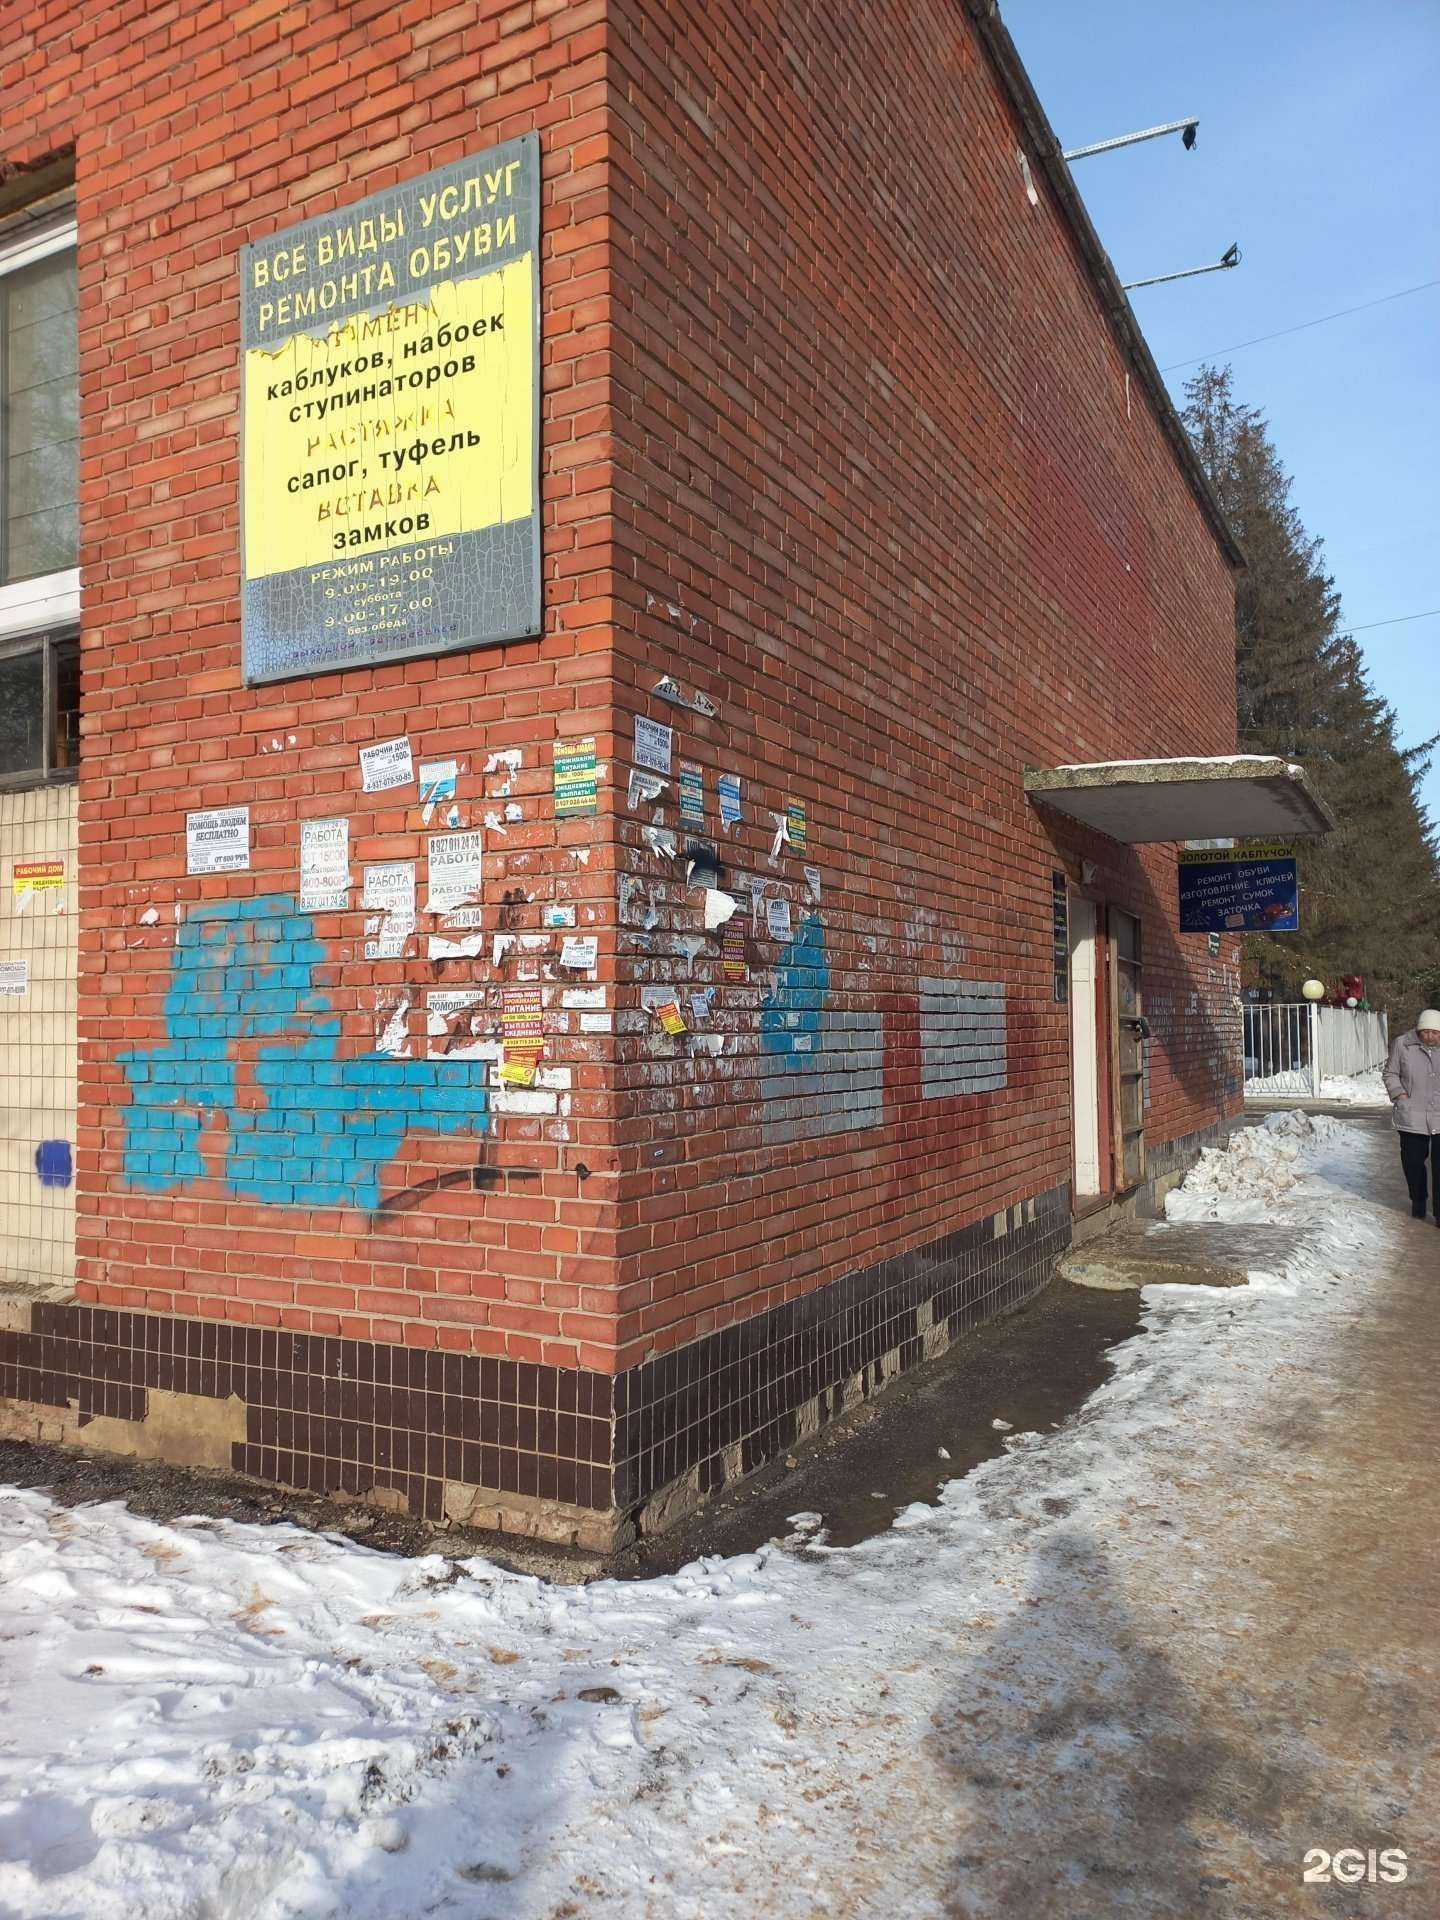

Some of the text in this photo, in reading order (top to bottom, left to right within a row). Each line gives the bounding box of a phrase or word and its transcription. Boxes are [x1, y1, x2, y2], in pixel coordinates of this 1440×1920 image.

[254, 160, 521, 288] ВСЕ ВИДЫ УСЛУГ
[259, 214, 516, 331] РЕМОНТА ОБУВИ
[267, 312, 504, 400] каблуков, набоек
[289, 354, 476, 423] ступинаторов
[287, 428, 481, 493] сапог, туфель
[333, 512, 430, 550] замков
[311, 542, 454, 583] РЕЖИМ РАБОТЫ
[353, 590, 402, 607] суббота
[325, 596, 433, 628] 9.00-17.00
[347, 617, 407, 636] без обеда
[394, 740, 409, 752] ДОМ
[188, 820, 219, 831] ПОМОЩЬ
[219, 816, 247, 828] ЛЮДЯМ
[196, 829, 239, 841] БЕСПЛАТНО
[304, 829, 343, 843] РАБОТА
[430, 839, 435, 854] 8
[436, 839, 449, 854] 927
[461, 836, 470, 851] 24
[470, 835, 480, 849] 24
[430, 852, 480, 866] РАБОТА
[1181, 849, 1294, 863] ЗОЛОТОЙ КАБЛУЧОК
[368, 873, 409, 888] РАБОТА
[1197, 866, 1270, 885] РЕМОНТ ОБУВИ
[431, 884, 479, 896] РАБОТЫ
[1181, 871, 1294, 900] ИЗГОТОВЛЕНИЕ КЛЮЧЕЙ
[1201, 889, 1275, 907] РЕМОНТ СУМОК
[1217, 902, 1261, 917] ЗАТОЧКА
[505, 1004, 541, 1013] ПИТАНИЕ
